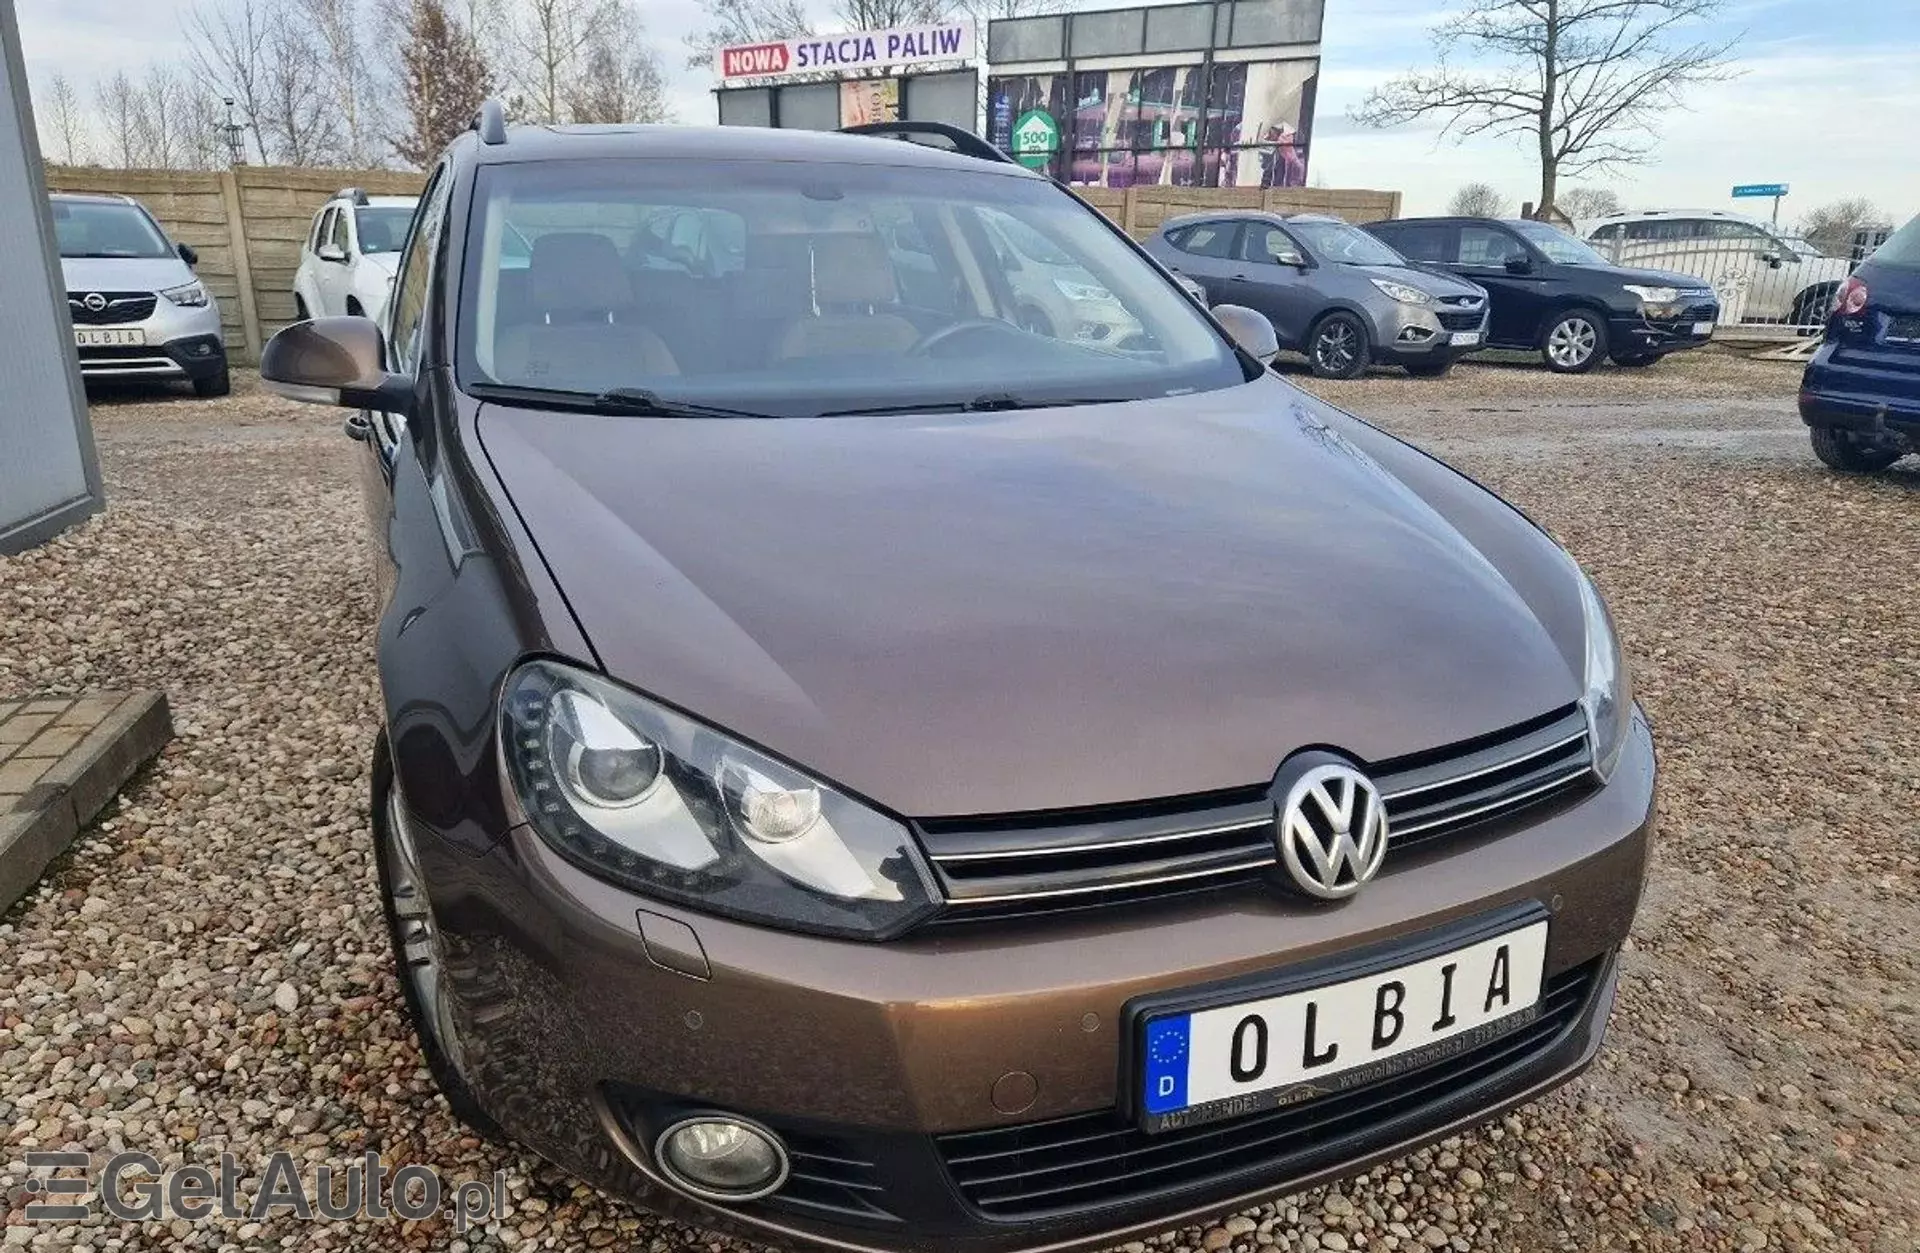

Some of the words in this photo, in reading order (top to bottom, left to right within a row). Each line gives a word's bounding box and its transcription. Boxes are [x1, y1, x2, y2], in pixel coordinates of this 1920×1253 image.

[729, 49, 783, 73] NOWA
[797, 37, 876, 67] STACJA
[888, 27, 961, 59] PALIW
[1022, 131, 1047, 145] 500
[1158, 1075, 1175, 1097] D
